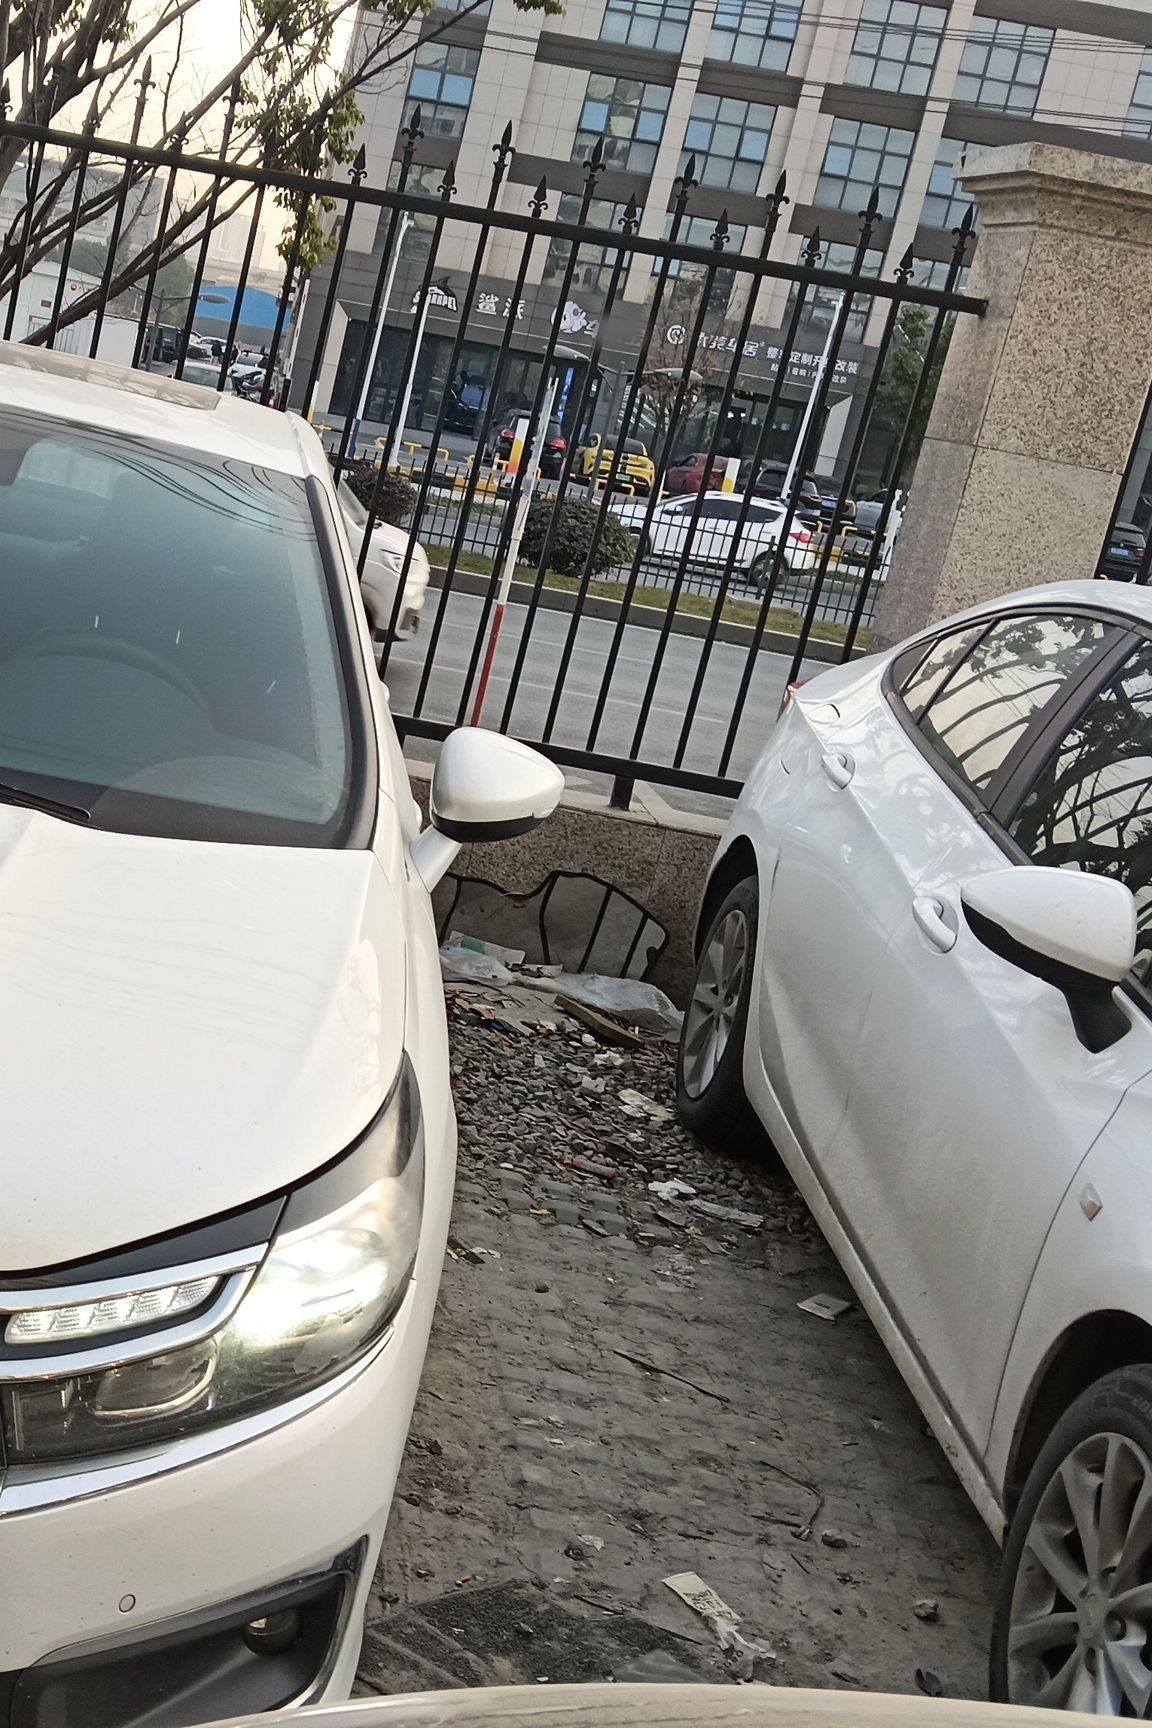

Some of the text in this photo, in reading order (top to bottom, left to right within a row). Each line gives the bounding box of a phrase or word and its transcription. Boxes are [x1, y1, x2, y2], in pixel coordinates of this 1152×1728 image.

[412, 291, 457, 312] SARKPEL
[767, 341, 859, 375] 整定制升改装
